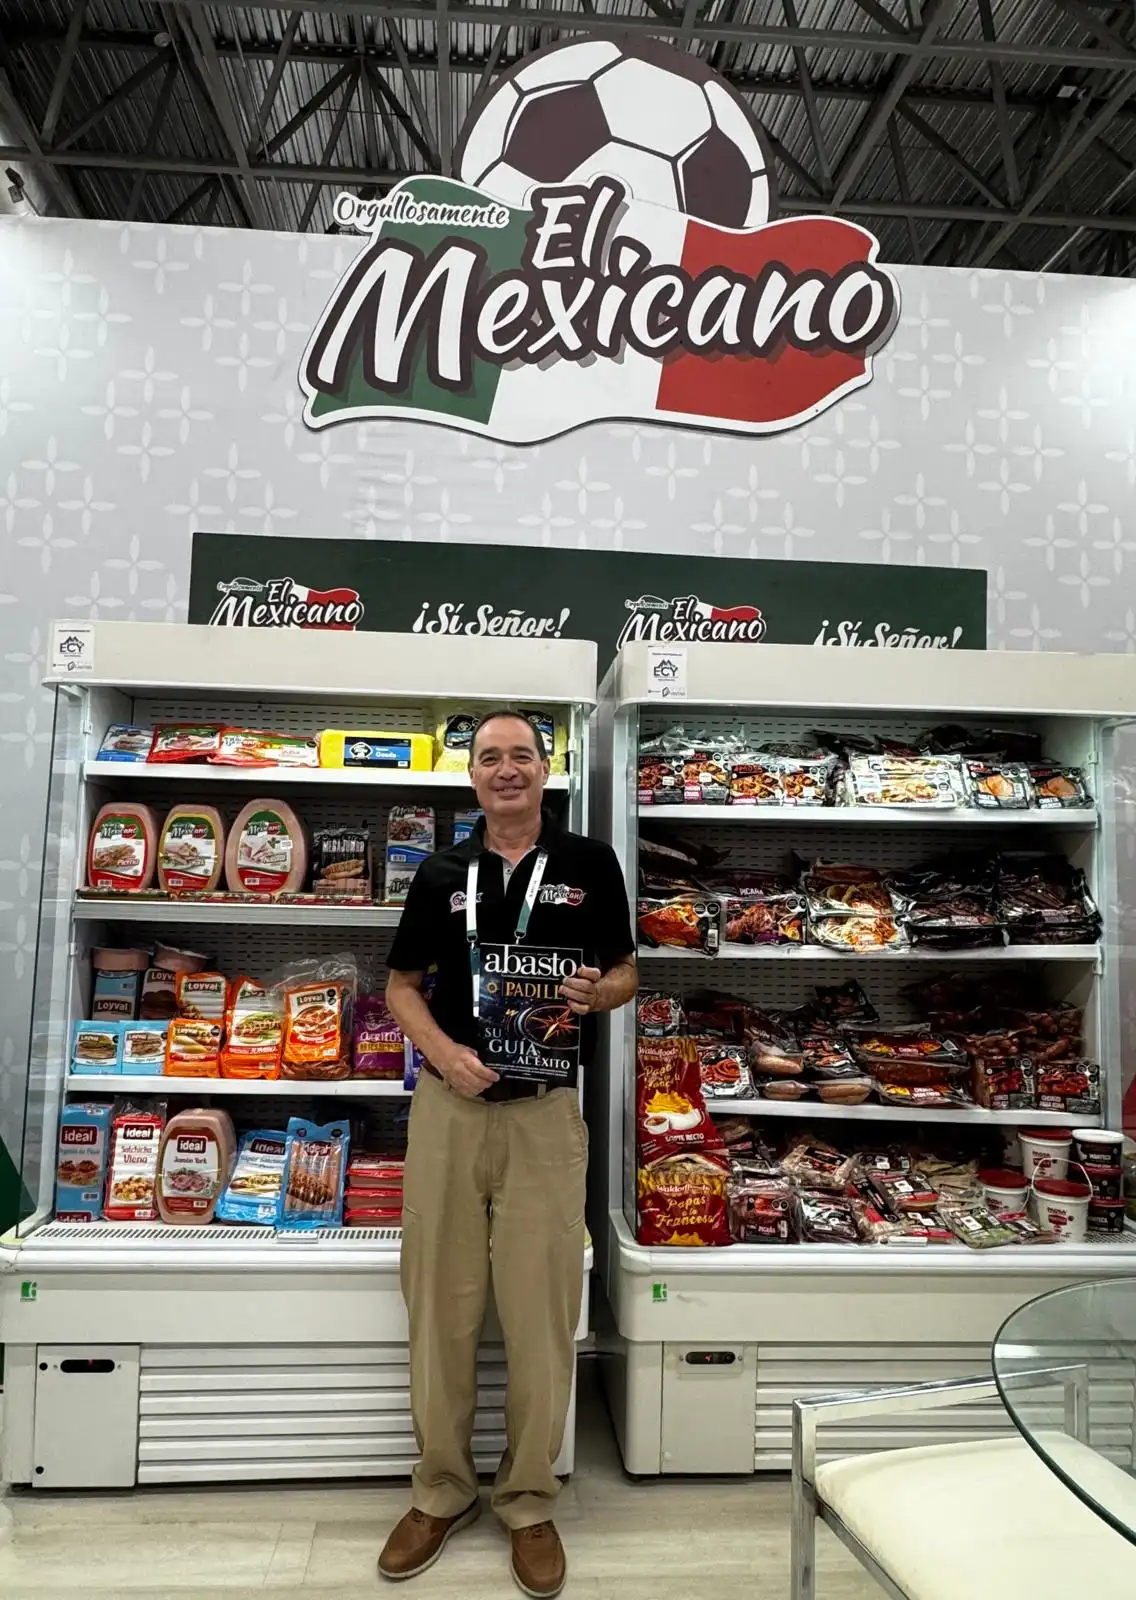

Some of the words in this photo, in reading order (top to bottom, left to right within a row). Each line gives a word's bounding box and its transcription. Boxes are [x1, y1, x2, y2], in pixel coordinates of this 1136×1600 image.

[336, 194, 509, 229] Orgullosamente
[530, 185, 615, 270] El
[316, 245, 885, 385] Mexicano
[269, 580, 293, 603] El
[213, 595, 361, 627] Mexicano
[673, 598, 693, 620] El
[412, 602, 465, 636] ¡Sí
[464, 604, 571, 638] Señor!
[624, 613, 763, 643] Mexicano
[60, 642, 85, 653] ECY
[653, 666, 678, 677] ECY
[484, 945, 578, 977] abasto
[151, 971, 176, 983] Loyv
[188, 982, 218, 993] Loyval
[505, 981, 564, 1000] PADILL
[97, 1001, 128, 1012] Loyval
[485, 1027, 502, 1039] SU
[488, 1037, 540, 1056] GUÍA
[516, 1055, 529, 1066] AL
[64, 1130, 93, 1142] ideal
[126, 1127, 151, 1138] ideal
[179, 1140, 204, 1151] ideal
[254, 1143, 285, 1155] ideal
[667, 1196, 706, 1212] Papas
[655, 1214, 716, 1228] Francesa
